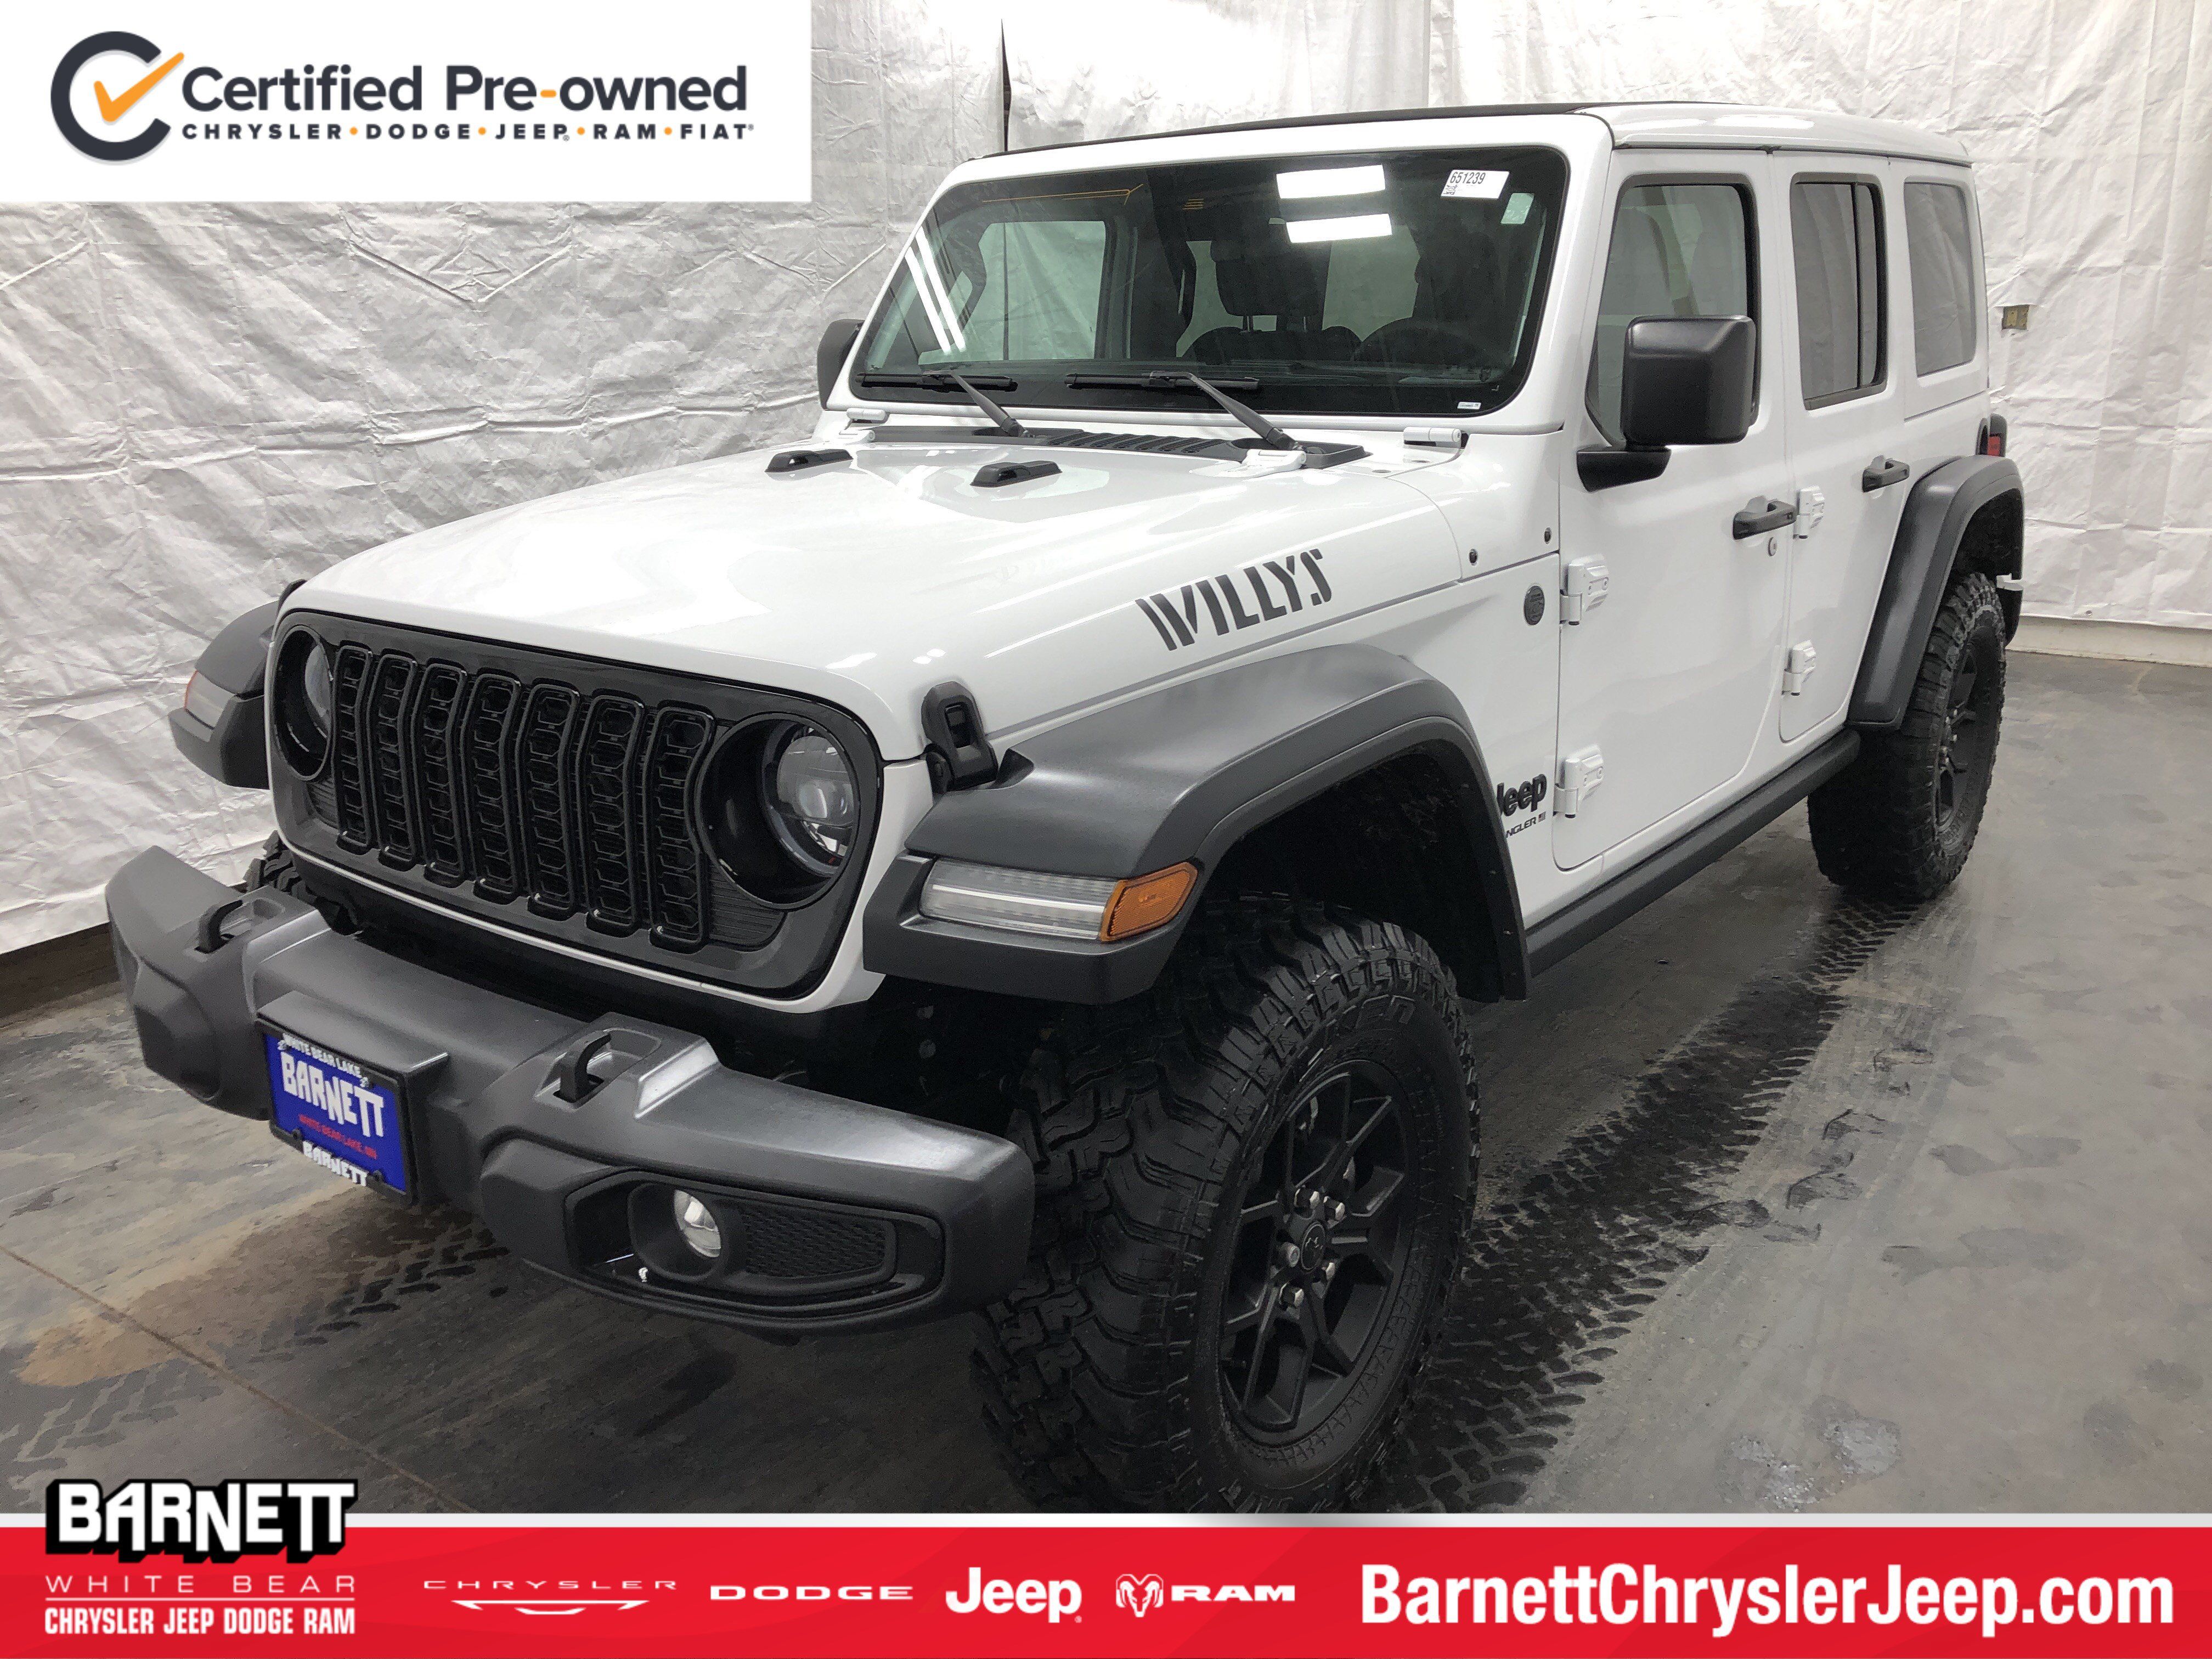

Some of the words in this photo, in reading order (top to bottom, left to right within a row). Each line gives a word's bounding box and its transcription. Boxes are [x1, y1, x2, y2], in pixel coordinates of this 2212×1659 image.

[1449, 171, 1486, 184] 651239
[1135, 548, 1332, 651] WILLYS
[280, 1052, 383, 1137] BARNETT
[302, 1140, 368, 1187] BARNETT
